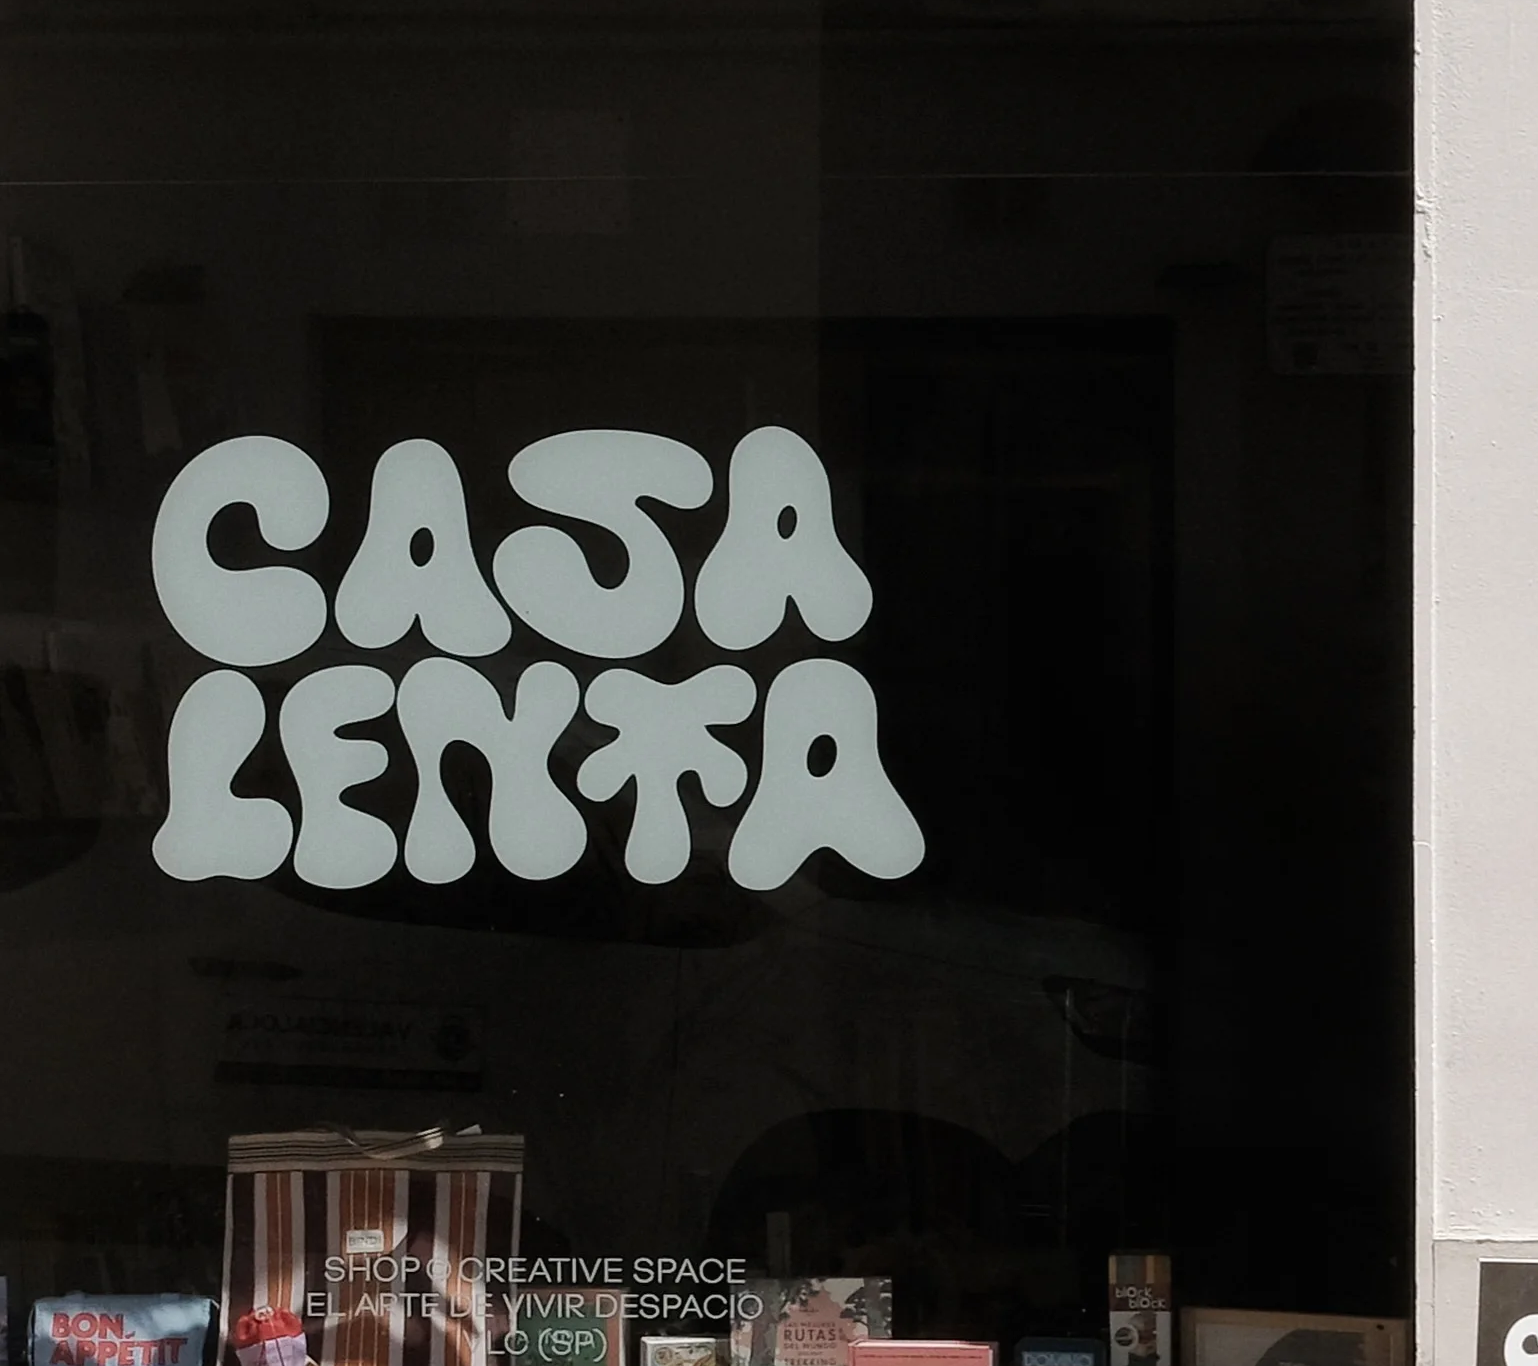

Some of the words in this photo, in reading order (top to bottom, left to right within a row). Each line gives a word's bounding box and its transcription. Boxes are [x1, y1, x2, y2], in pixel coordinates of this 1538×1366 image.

[151, 426, 874, 667] CASA
[151, 657, 927, 891] LENTA
[324, 1256, 420, 1283] SHOP
[459, 1256, 623, 1284] CREATIVE
[633, 1256, 747, 1285] SPACE
[307, 1293, 345, 1318] EL
[355, 1293, 440, 1318] ARTE
[450, 1294, 493, 1318] DE
[504, 1293, 584, 1319] VIVIR
[595, 1293, 764, 1320] DESPACIO
[52, 1312, 125, 1339] BON
[784, 1328, 836, 1342] RUTAS
[538, 1328, 608, 1363] (SP)
